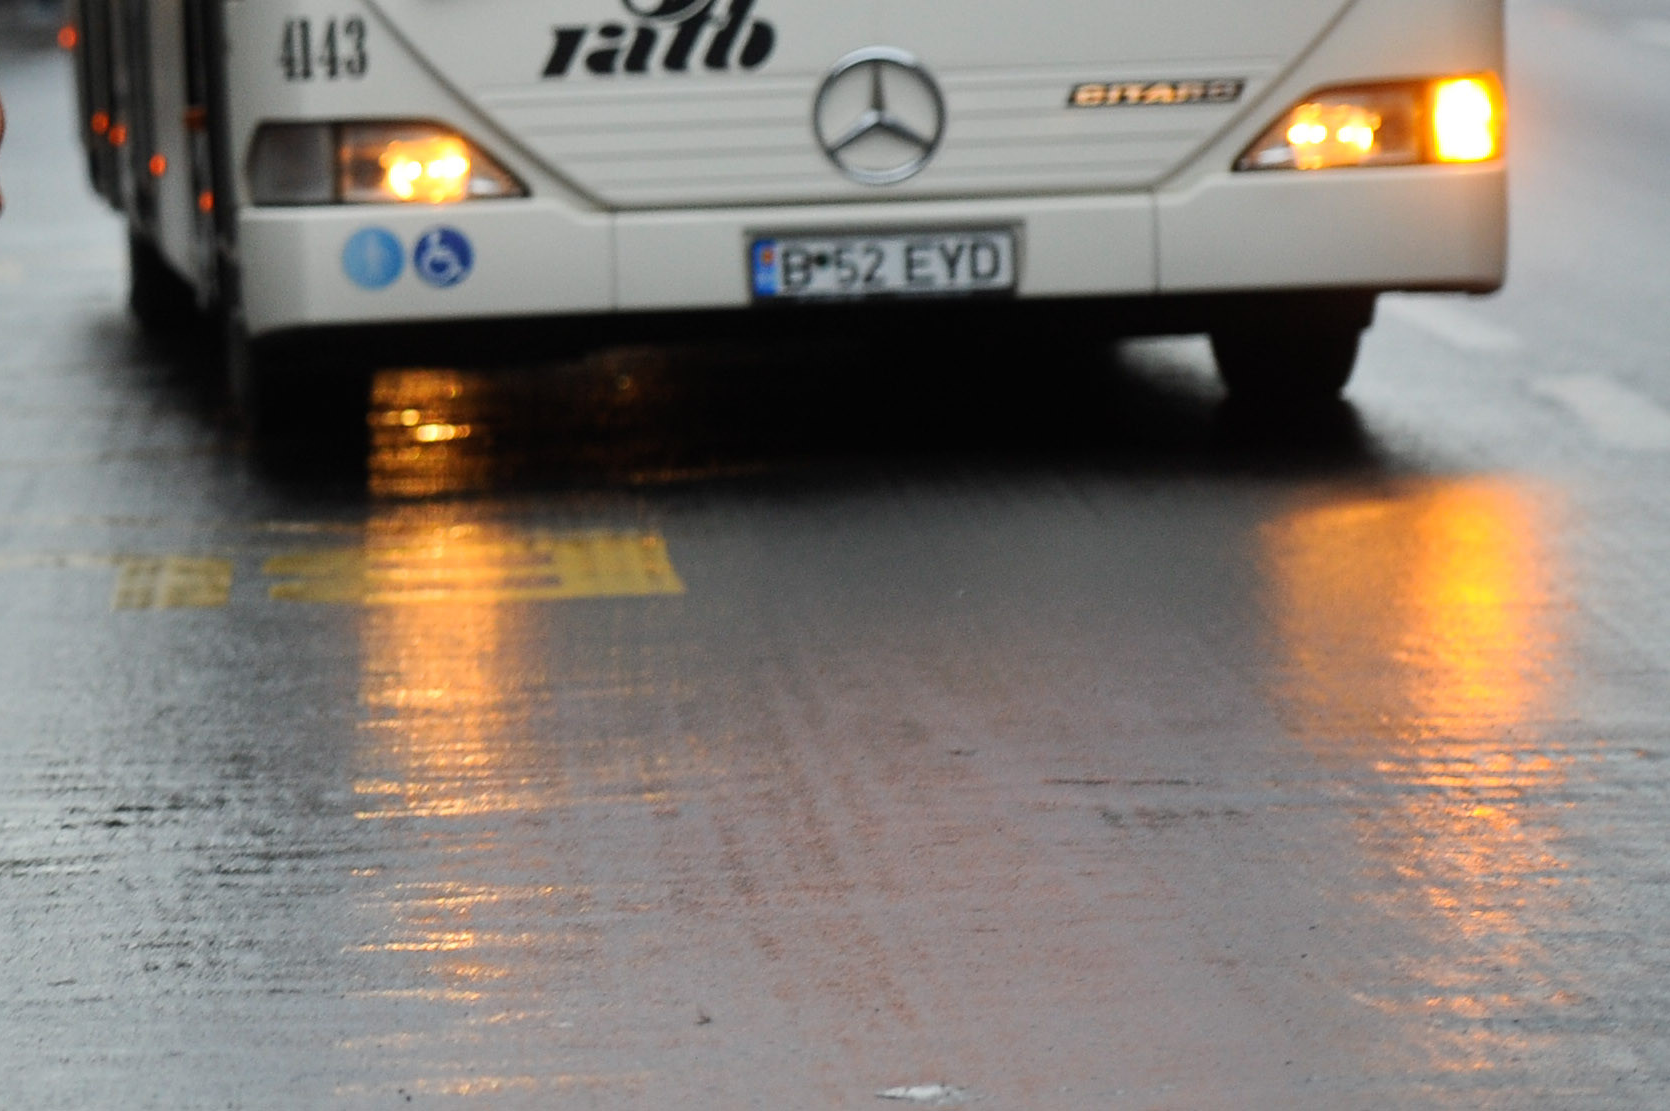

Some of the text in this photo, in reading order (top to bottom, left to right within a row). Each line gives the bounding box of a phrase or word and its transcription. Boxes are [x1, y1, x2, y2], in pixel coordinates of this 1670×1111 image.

[280, 17, 367, 80] 4143
[783, 248, 812, 286] B
[835, 247, 885, 284] 52
[906, 241, 1000, 283] EYD
